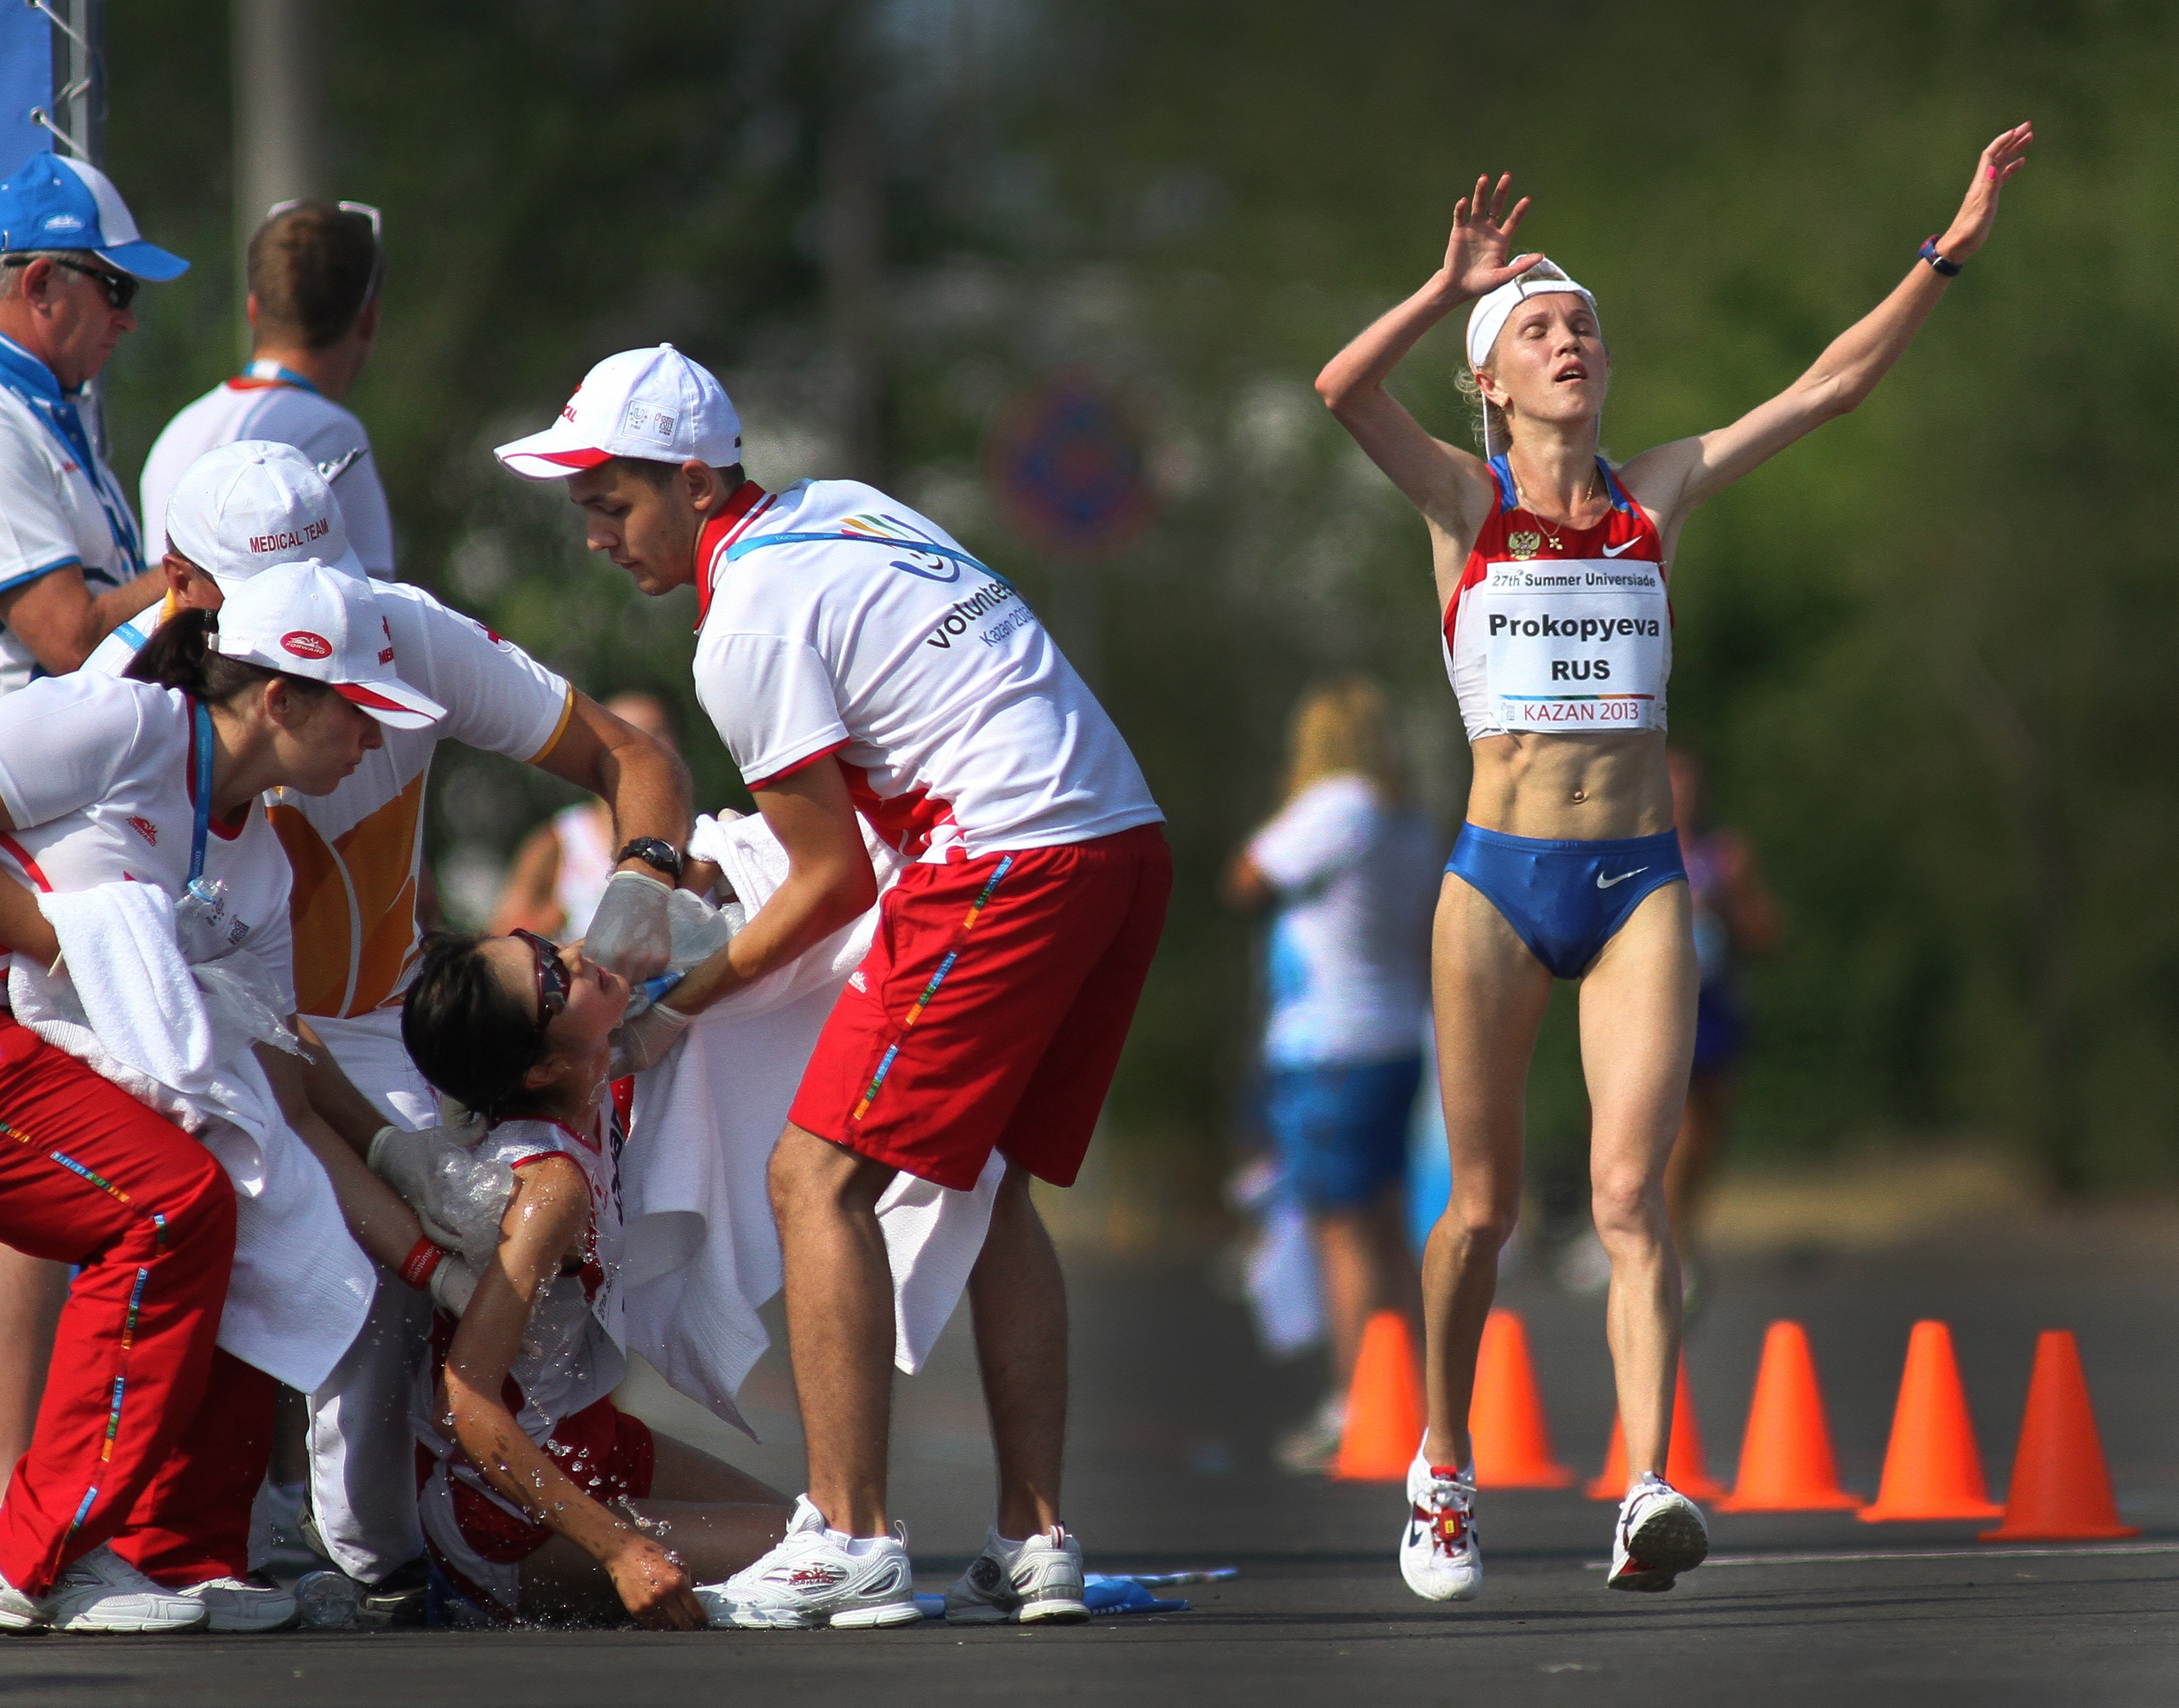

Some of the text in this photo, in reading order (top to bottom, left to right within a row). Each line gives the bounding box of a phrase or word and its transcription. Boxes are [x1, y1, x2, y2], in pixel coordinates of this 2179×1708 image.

[249, 517, 329, 553] MEDICAL TEAM
[1492, 572, 1656, 587] 27th Summer Universiade
[926, 580, 1014, 648] voluntee
[979, 620, 1016, 648] Kazan
[1489, 614, 1660, 643] Prokopyeva
[284, 643, 326, 655] FORWARD
[1552, 660, 1611, 681] RUS
[1524, 704, 1594, 721] KAZAN
[1599, 702, 1639, 720] 2013
